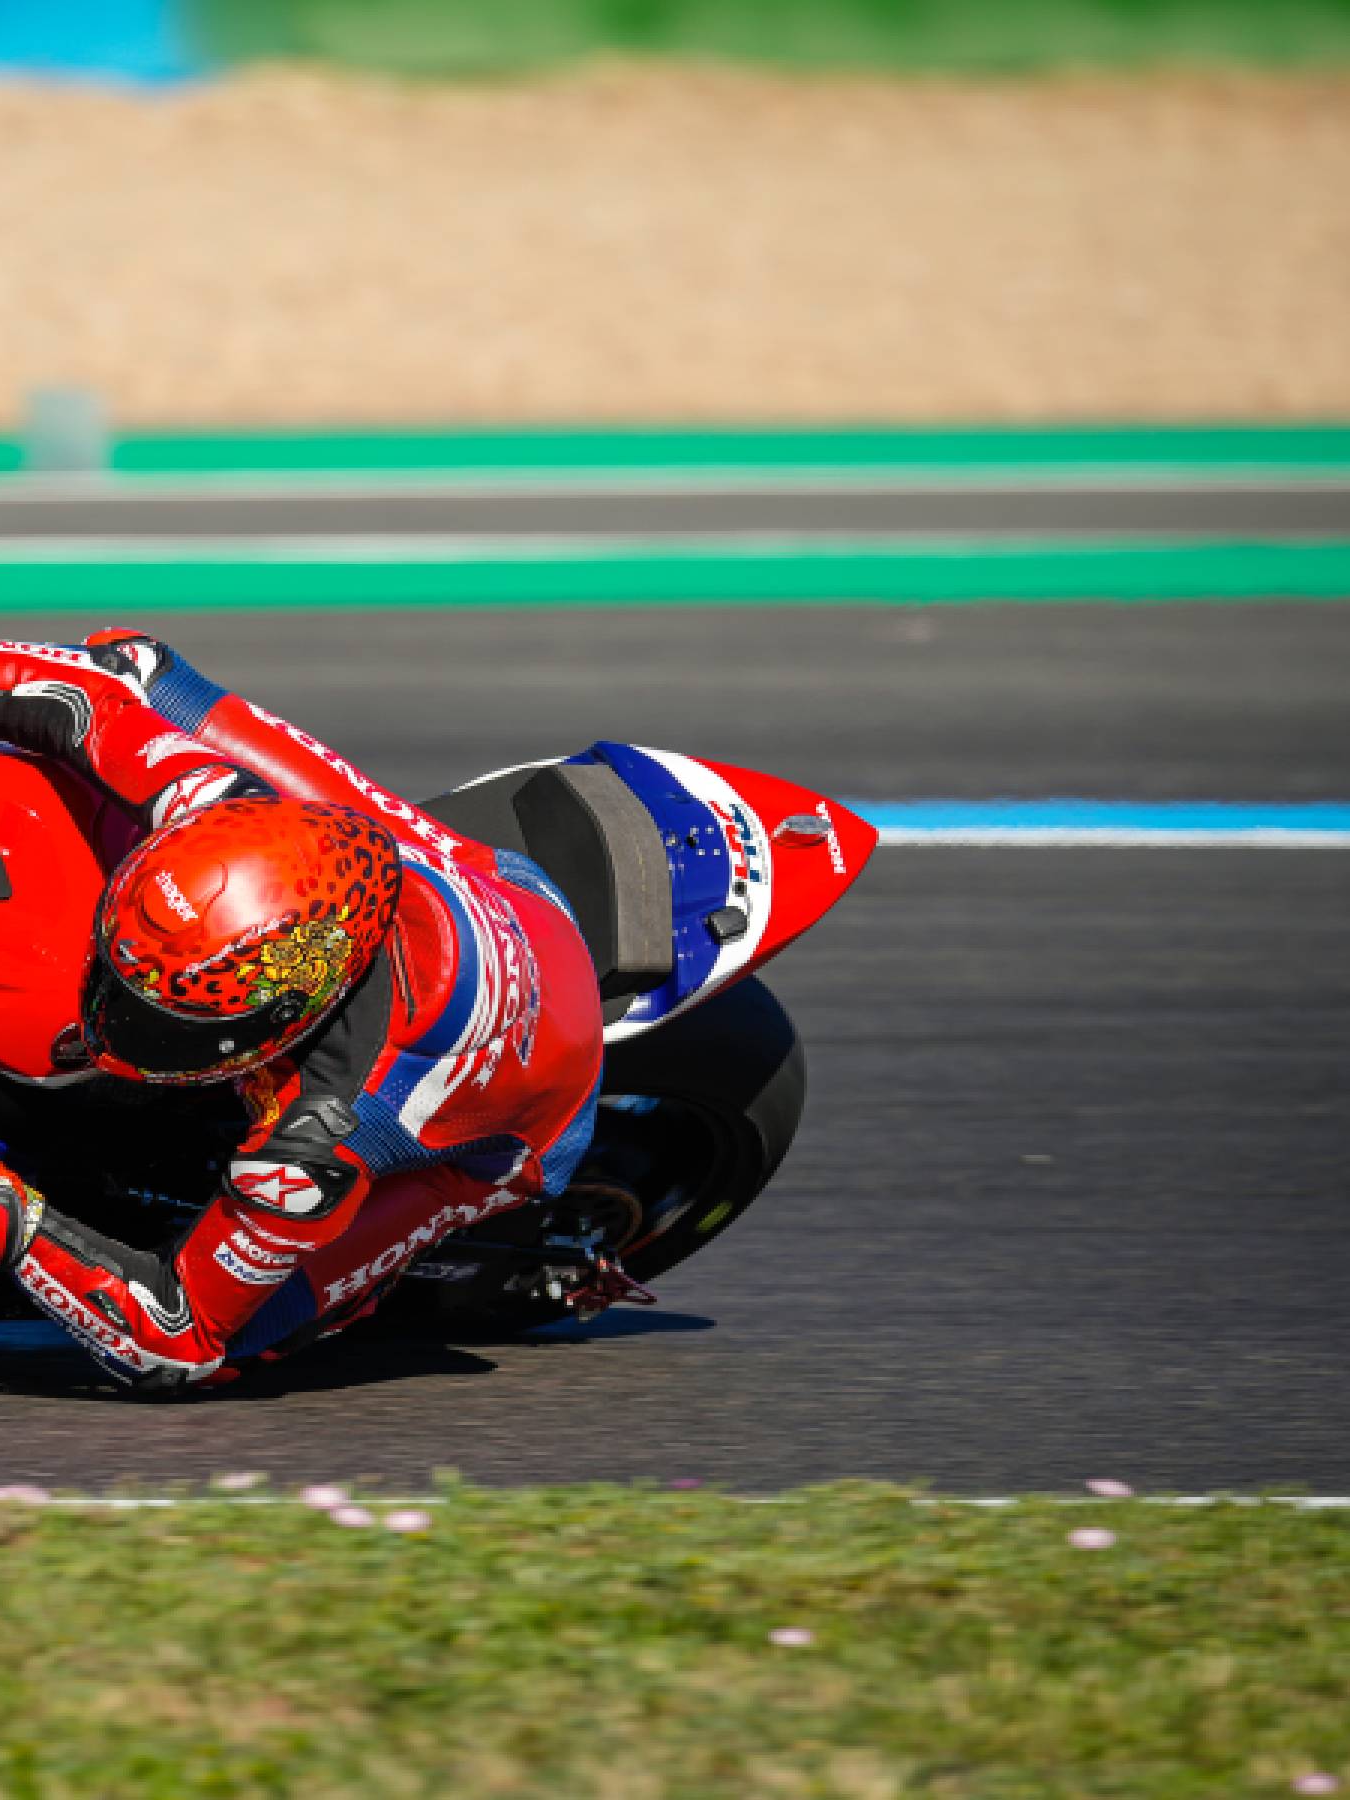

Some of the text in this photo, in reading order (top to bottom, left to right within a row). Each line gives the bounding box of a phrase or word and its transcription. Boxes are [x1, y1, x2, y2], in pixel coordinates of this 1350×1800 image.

[815, 800, 847, 874] HONA
[322, 1187, 519, 1309] HONDA
[19, 1262, 145, 1369] HONDA
